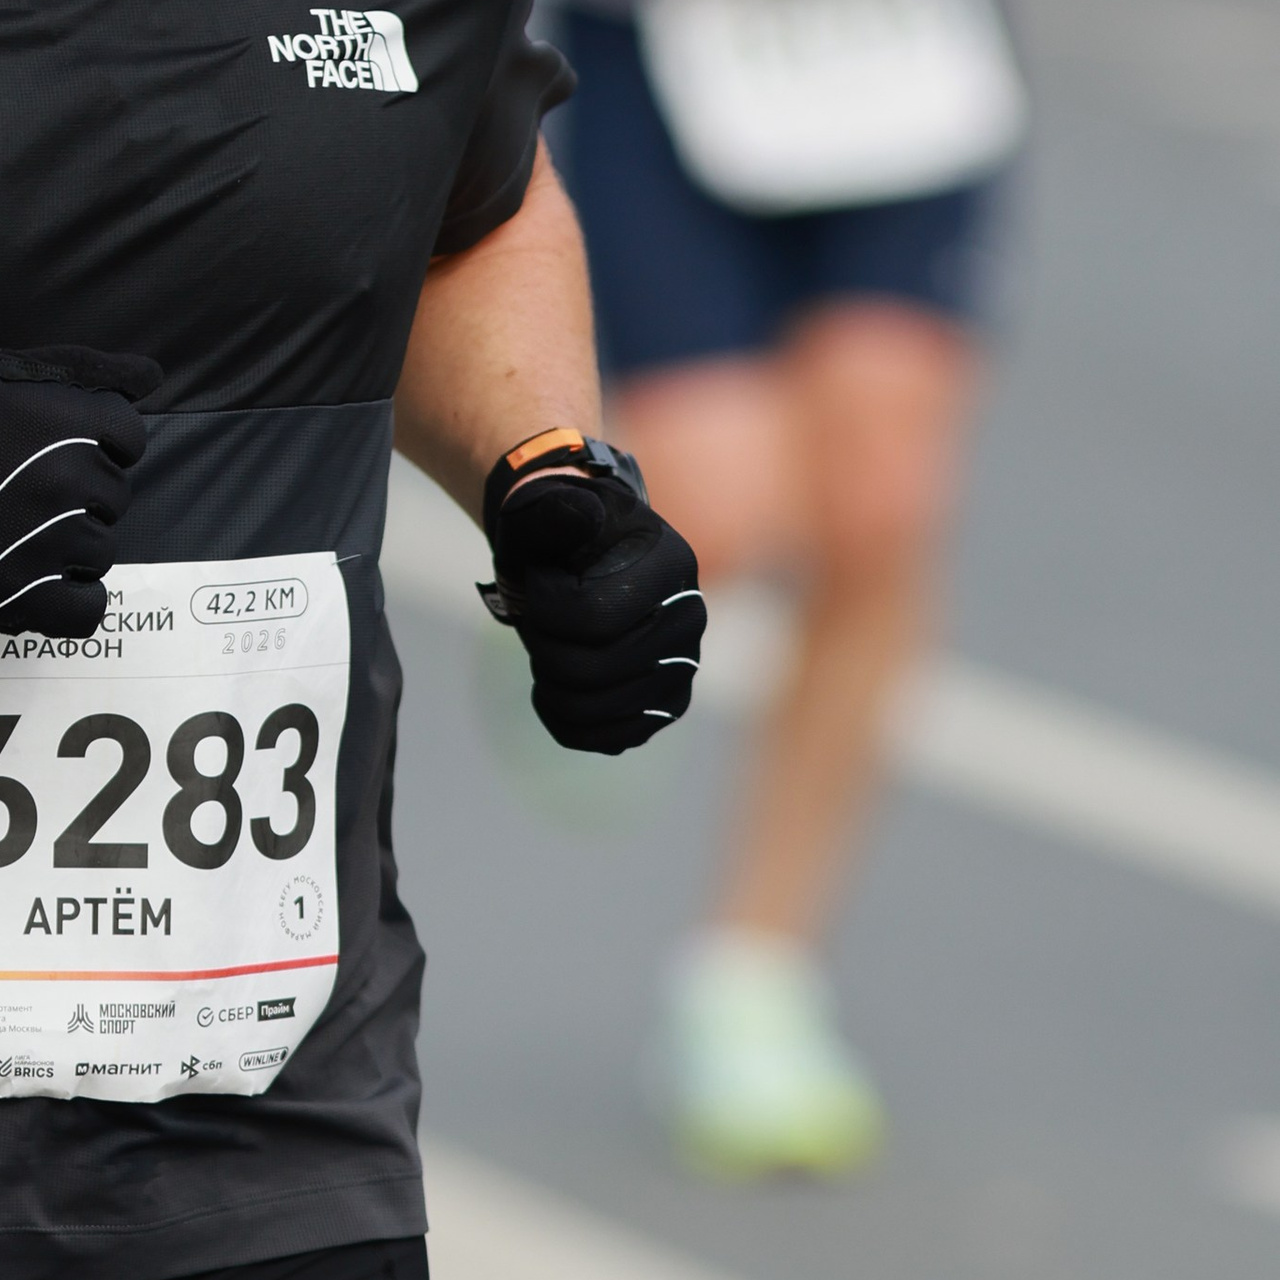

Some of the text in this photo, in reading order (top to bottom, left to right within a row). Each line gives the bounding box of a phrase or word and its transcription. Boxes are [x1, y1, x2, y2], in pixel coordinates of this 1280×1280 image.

[309, 8, 373, 36] THE
[267, 33, 374, 63] NORTH
[306, 60, 374, 90] FACE
[206, 589, 257, 617] 42,2
[222, 627, 287, 655] 2026
[23, 887, 173, 936] АРТЁМ
[293, 895, 305, 920] 1
[99, 1000, 176, 1018] МОСКОВСКИЙ
[218, 1006, 254, 1022] СБЕР
[260, 1003, 290, 1017] Прайм
[8, 1025, 42, 1033] Москвы
[99, 1019, 136, 1034] СПОРТ
[202, 1060, 223, 1071] сбп
[243, 1052, 281, 1067] WINLINE
[14, 1067, 55, 1078] BRICS
[91, 1063, 163, 1075] магнит
